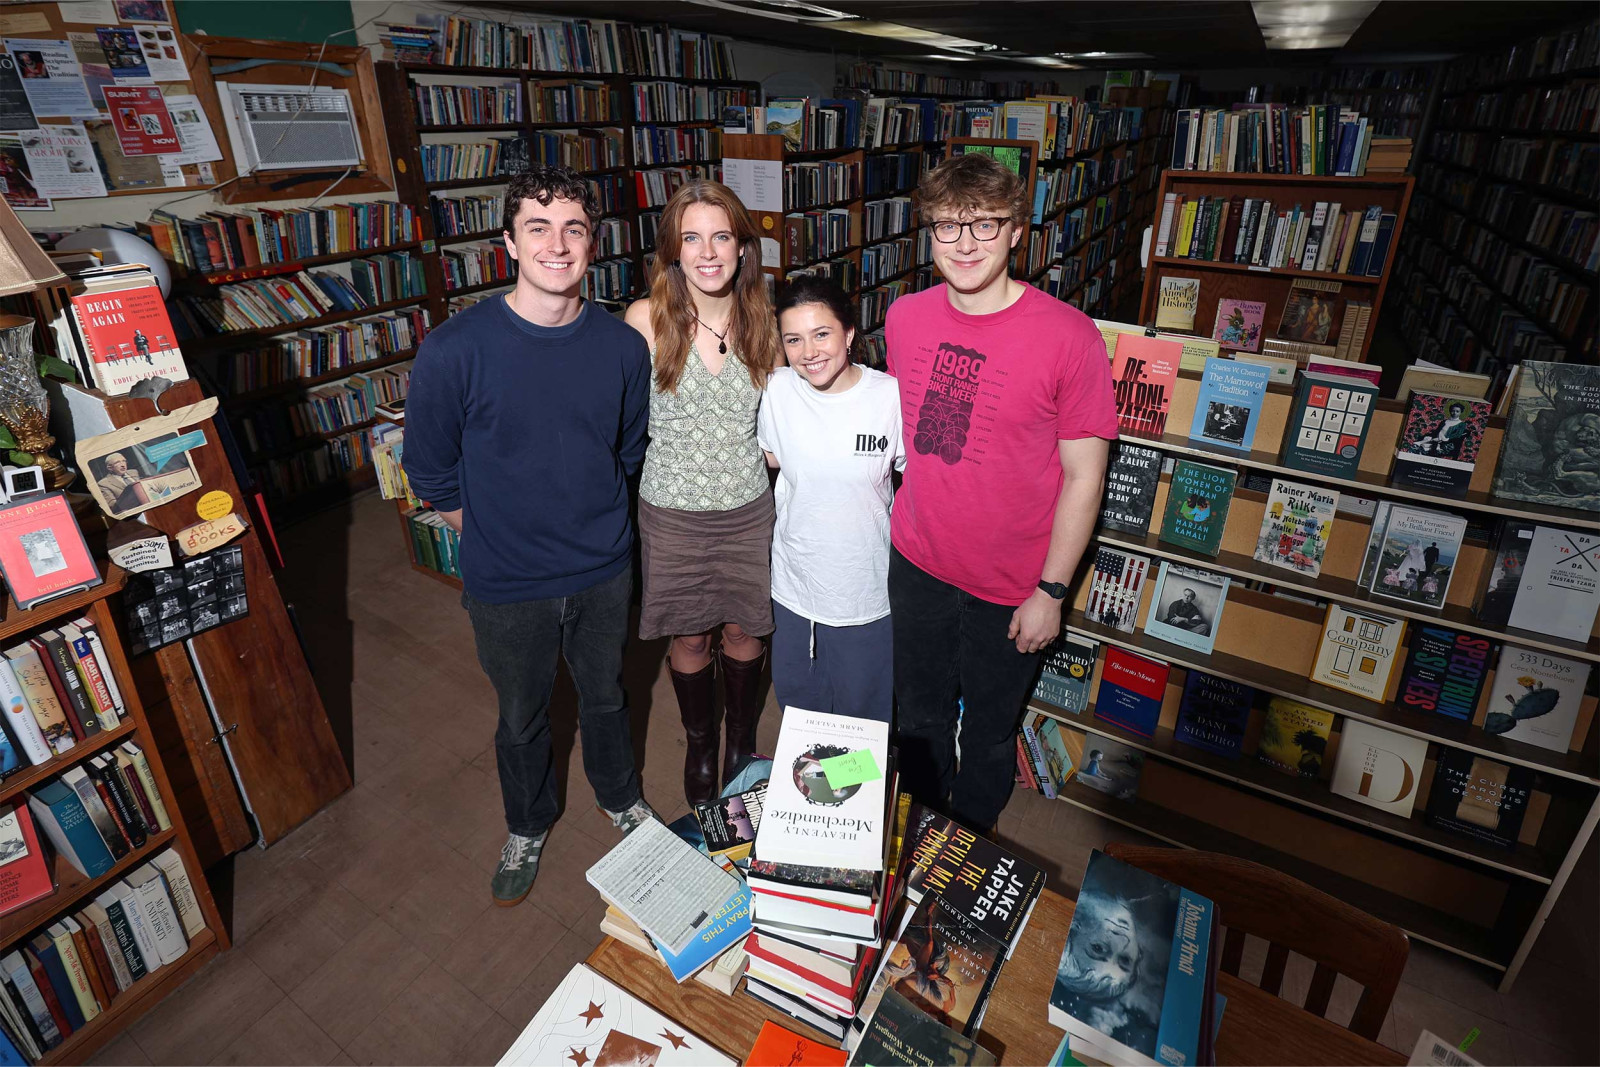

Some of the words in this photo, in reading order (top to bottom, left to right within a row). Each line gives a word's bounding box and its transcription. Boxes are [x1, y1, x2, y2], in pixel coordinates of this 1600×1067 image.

[40, 136, 87, 146] READING
[1168, 281, 1184, 291] The
[1161, 296, 1195, 310] History
[1163, 289, 1187, 302] Angel
[1187, 291, 1195, 302] of
[86, 299, 123, 314] BEGIN
[1240, 302, 1262, 310] BUNNY
[92, 313, 125, 327] AGAIN
[935, 348, 985, 384] 1989
[1122, 356, 1148, 383] DE-
[1210, 363, 1232, 373] Charles
[1240, 368, 1266, 379] Chesnutt
[931, 372, 954, 386] FRONT
[955, 378, 979, 394] RANGE
[1209, 372, 1224, 382] The
[1225, 376, 1253, 388] Marrow
[1254, 381, 1264, 389] of
[928, 380, 948, 394] BIKE
[950, 386, 976, 403] WEEK
[1218, 384, 1249, 397] Tradition
[1116, 402, 1168, 436] ZATION
[1124, 445, 1141, 456] THE
[1141, 448, 1157, 458] SEA
[1126, 457, 1150, 469] ALIVE
[1177, 476, 1210, 490] WOMEN
[1214, 484, 1228, 493] OF
[1183, 468, 1199, 477] THE
[1203, 472, 1226, 484] LION
[1108, 482, 1131, 492] STORY
[1132, 487, 1142, 495] OF
[1108, 492, 1130, 503] D-DAY
[1184, 485, 1217, 500] TEHRAN
[1277, 483, 1305, 497] Rainer
[1308, 490, 1334, 505] Maria
[0, 510, 22, 519] ONE
[26, 500, 61, 514] BLACK
[1116, 512, 1123, 520] M.
[1124, 514, 1144, 525] GRAFF
[189, 521, 215, 538] ART
[1175, 518, 1209, 534] MARJAN
[1269, 512, 1281, 520] The
[1282, 516, 1315, 530] Notebooks
[1316, 524, 1325, 533] of
[1397, 521, 1407, 529] My
[1408, 523, 1434, 534] Brilliant
[1435, 527, 1455, 537] Friend
[1406, 516, 1421, 524] Elena
[1422, 519, 1449, 530] Ferrante
[187, 525, 236, 549] BOOKS
[1174, 527, 1206, 541] KAMALI
[1271, 522, 1292, 534] Malte
[1294, 528, 1321, 542] Laurids
[1280, 534, 1304, 547] Brigge
[1579, 536, 1590, 544] DA
[144, 540, 166, 550] SOME
[121, 548, 157, 561] Sustained
[125, 554, 156, 565] Reading
[38, 583, 52, 593] bell
[55, 578, 76, 588] hooks
[1550, 575, 1575, 585] TRISTAN
[1577, 579, 1596, 588] TZARA
[1326, 629, 1393, 659] Company
[1422, 627, 1455, 643] A
[1414, 651, 1448, 673] IS
[1519, 652, 1538, 664] 533
[1541, 657, 1572, 674] Days
[1436, 635, 1490, 721] SPECTRUM
[1510, 662, 1529, 673] Cees
[1531, 666, 1575, 684] Nooteboom
[85, 658, 98, 679] KARL
[94, 682, 112, 707] MARX
[1037, 680, 1080, 701] WALTER
[1200, 675, 1242, 696] SIGNAL
[1322, 673, 1348, 686] Shannon
[1349, 682, 1374, 695] Sanders
[1035, 688, 1079, 710] MOSLEY
[1200, 689, 1234, 707] FIRES
[1403, 676, 1441, 710] SEX
[804, 717, 838, 729] VALERI
[841, 722, 865, 732] MARK
[1198, 716, 1227, 732] DANI
[1275, 709, 1324, 727] UNTAMED
[1282, 716, 1313, 729] STATE
[1183, 725, 1236, 748] SHAPIRO
[1259, 756, 1293, 772] ROXANE
[1447, 768, 1472, 780] THE
[1480, 778, 1526, 797] CURSE
[1452, 787, 1468, 797] DE
[1476, 794, 1512, 810] SADE
[1459, 781, 1522, 805] MARQUIS
[770, 808, 873, 833] Merchandize
[782, 825, 858, 841] HEAVENLY
[947, 827, 977, 867] DEVIL
[655, 865, 666, 874] the
[955, 860, 987, 892] THE
[170, 878, 188, 917] UNIVERSITY
[177, 875, 186, 884] Mr.
[182, 884, 197, 911] Jefferson's
[630, 885, 645, 900] land
[636, 888, 653, 906] eliot
[970, 856, 1016, 921] TAPPER
[993, 873, 1024, 921] JAKE
[155, 898, 164, 909] Mr.
[715, 893, 747, 920] LETTER
[934, 895, 974, 929] HARMONY
[128, 902, 137, 920] Harry
[134, 917, 143, 930] Byrd
[144, 902, 167, 941] UNIVERSITY
[159, 907, 174, 934] Jefferson's
[724, 907, 749, 928] PRAY
[1182, 904, 1206, 943] Johann
[701, 924, 725, 944] THIS
[934, 922, 970, 954] CADMUS
[959, 930, 978, 944] AND
[113, 919, 130, 947] Martin's
[123, 943, 140, 973] Hundred
[971, 950, 984, 960] OF
[942, 941, 989, 976] MARRIAGE
[1178, 939, 1199, 976] Arndt
[960, 967, 976, 980] THE
[877, 1012, 899, 1032] Editors
[869, 1032, 882, 1046] and
[873, 1021, 906, 1047] Weingast,
[902, 1042, 912, 1052] R.
[914, 1049, 934, 1067] Barry
